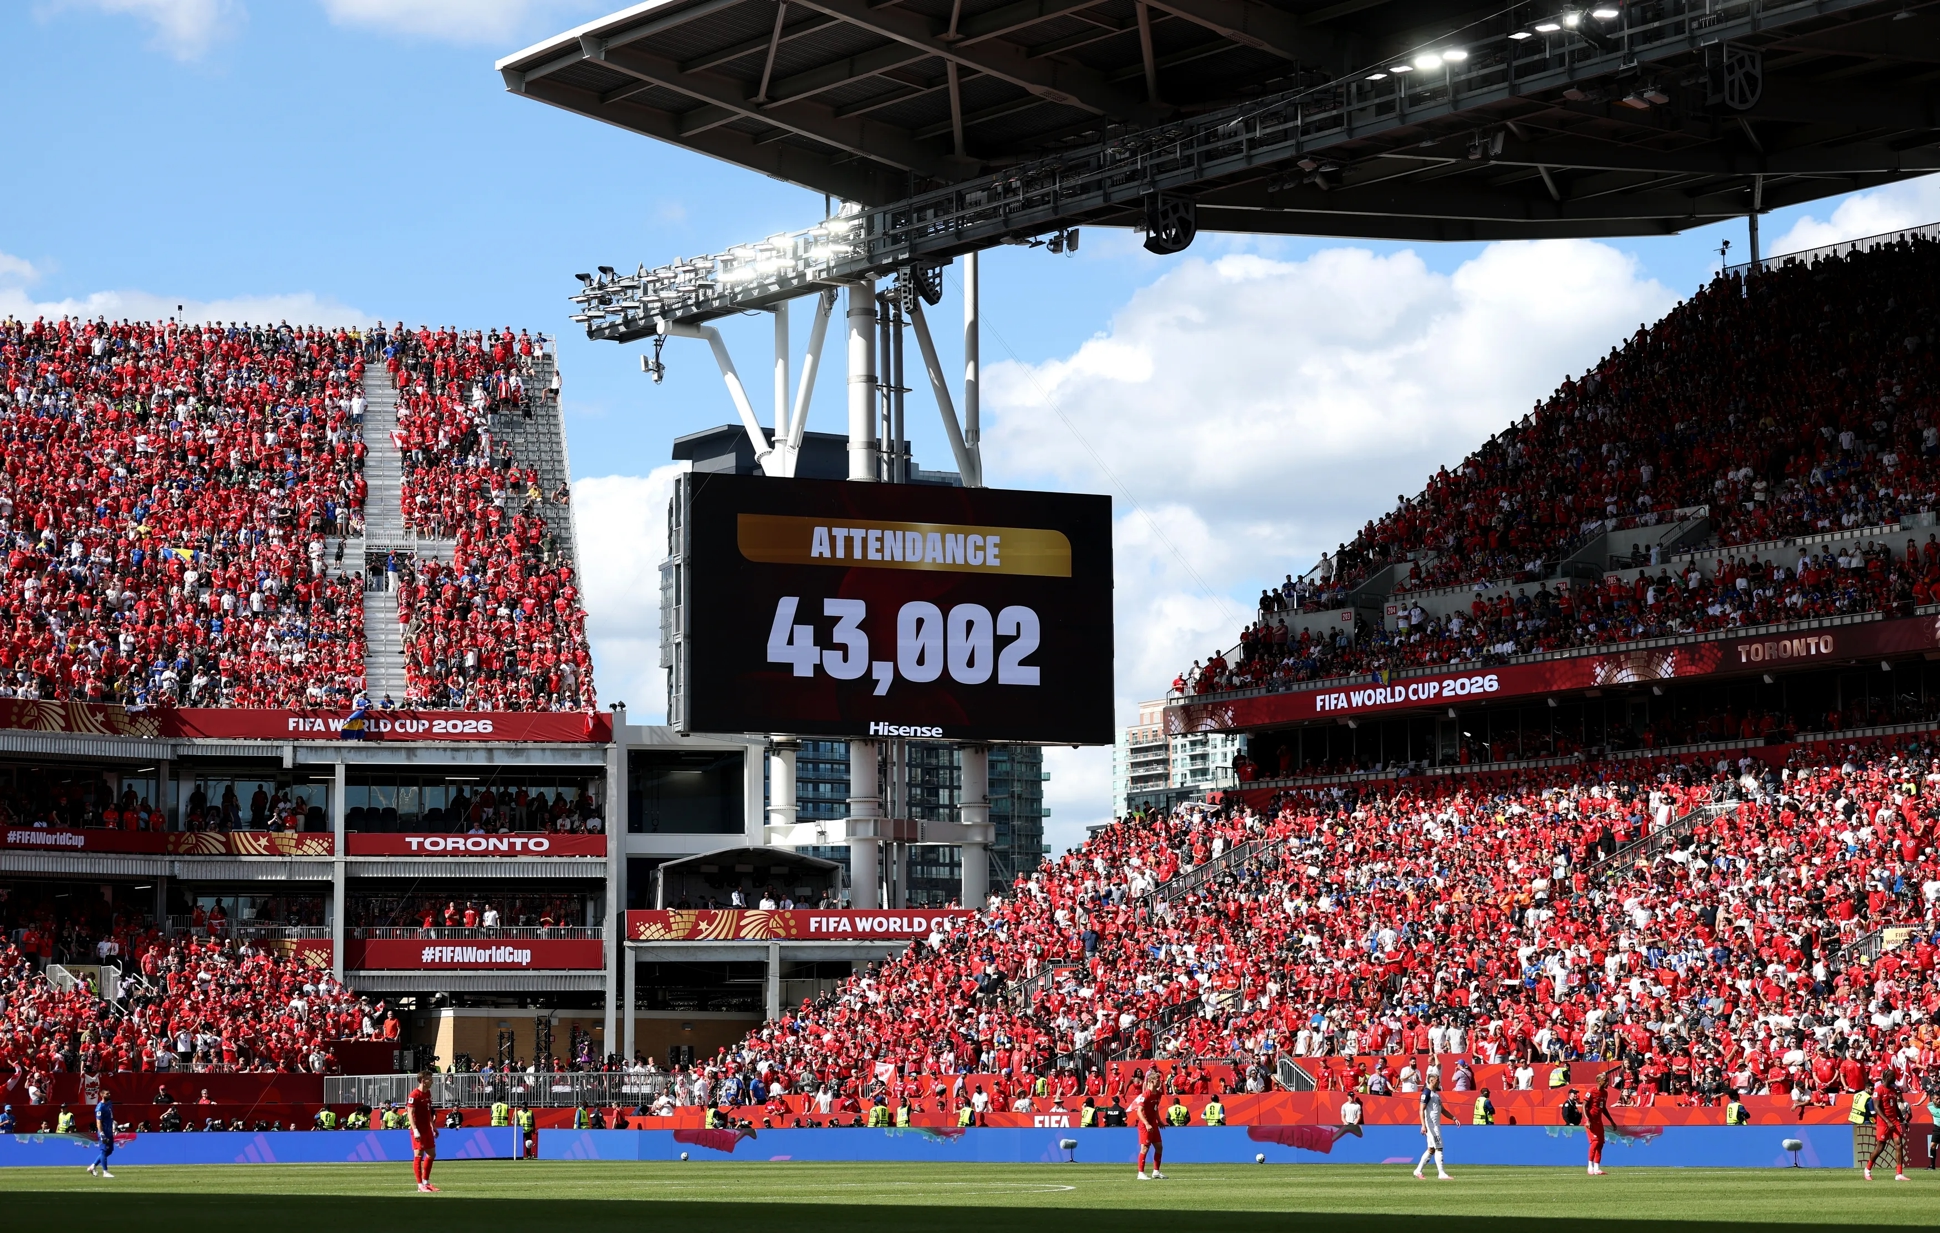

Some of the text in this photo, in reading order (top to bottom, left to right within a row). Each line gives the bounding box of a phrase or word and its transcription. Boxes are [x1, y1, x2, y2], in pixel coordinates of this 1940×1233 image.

[811, 526, 1000, 566] ATTENDANCE
[767, 596, 1041, 696] 43,002
[1738, 635, 1834, 663] TORONTO
[1316, 674, 1500, 712] FIFA WORLD CUP 2026
[288, 718, 494, 733] FIFA WRLD CUP 2026
[869, 721, 943, 737] Hisense
[7, 830, 85, 848] #FIFAWorldCup
[405, 837, 550, 851] TORONTO
[809, 916, 852, 932] FIFA
[855, 916, 927, 932] WORLD
[422, 946, 531, 966] #FIFAWorldCup
[1034, 1115, 1070, 1128] FIFA
